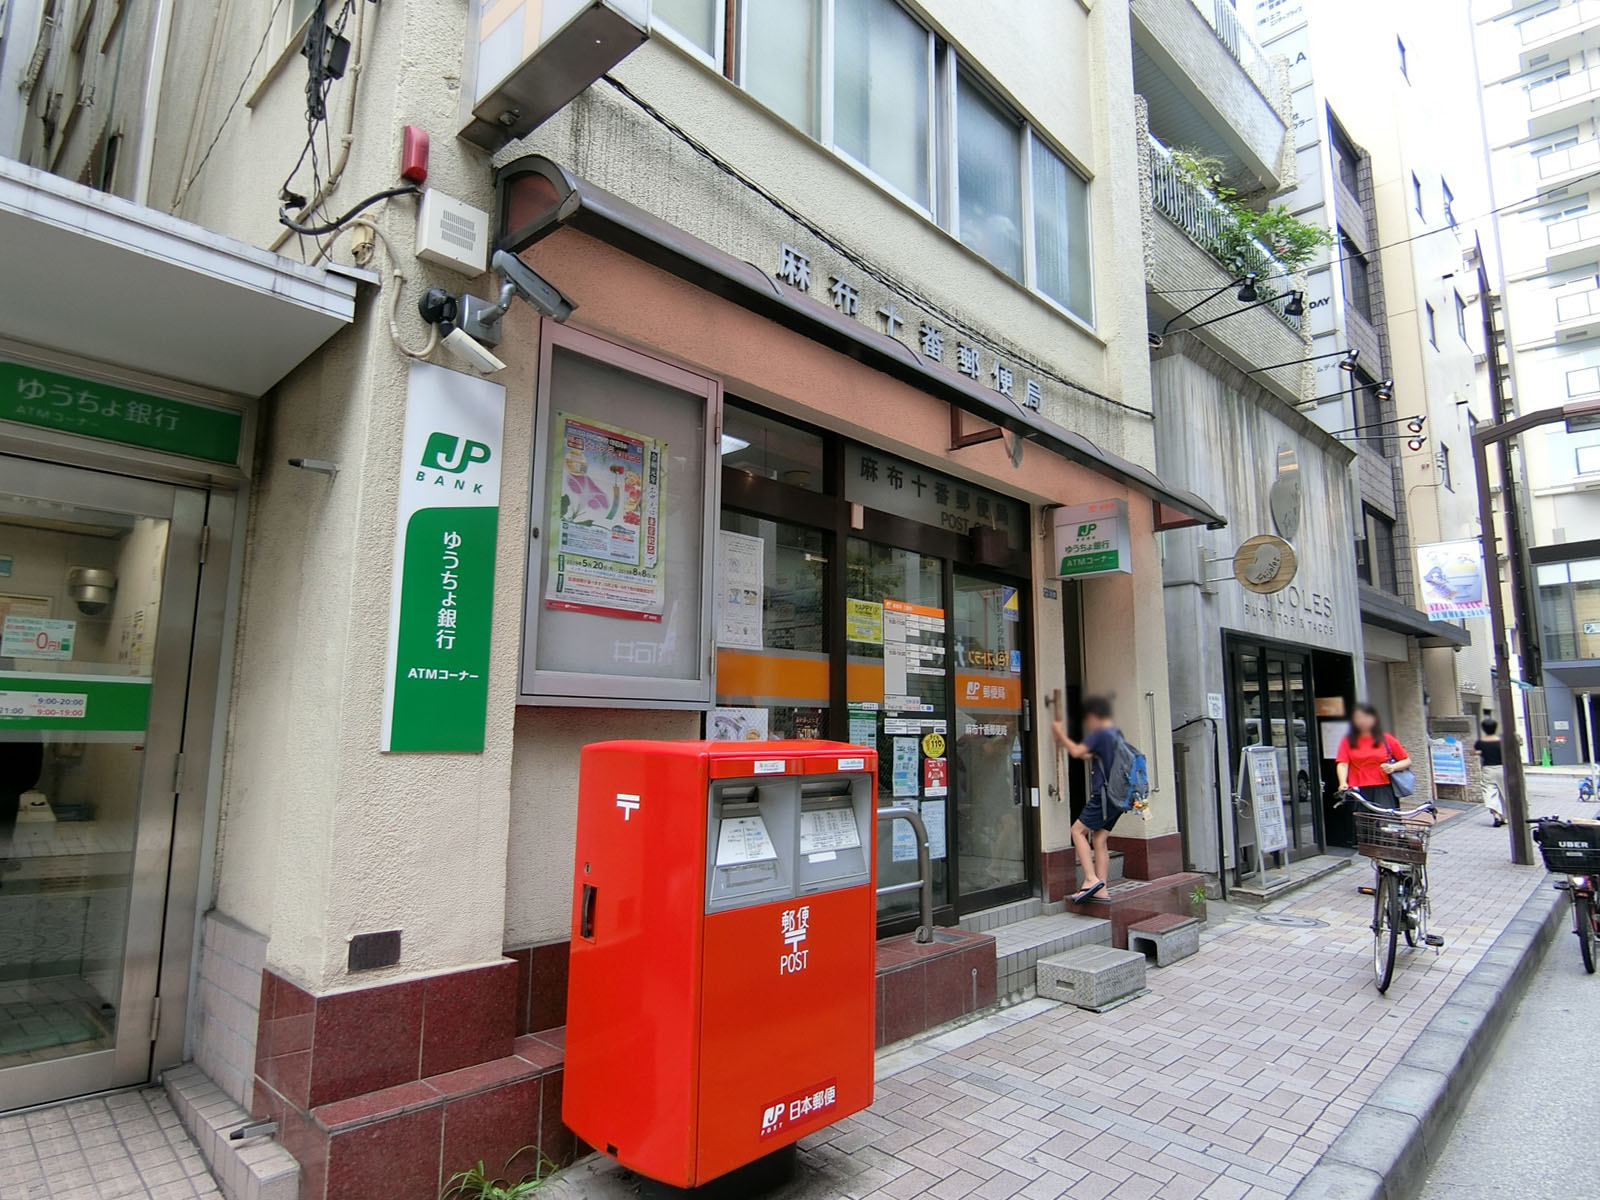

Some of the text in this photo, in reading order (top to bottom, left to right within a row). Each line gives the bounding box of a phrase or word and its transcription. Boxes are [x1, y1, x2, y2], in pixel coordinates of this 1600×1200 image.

[777, 242, 1043, 413] 麻布十番郵便局
[17, 378, 181, 431] ゆうちょ銀行
[416, 471, 484, 494] BANK
[1065, 540, 1111, 554] ゆうちょ銀行
[435, 531, 462, 650] ゆうちょ銀行
[407, 667, 479, 682] ATMコーナー
[38, 697, 84, 705] 9:00-20:00
[781, 906, 810, 934] 郵便
[780, 950, 808, 975] POST
[789, 1085, 836, 1121] 日本郵便
[760, 1122, 783, 1136] POST
